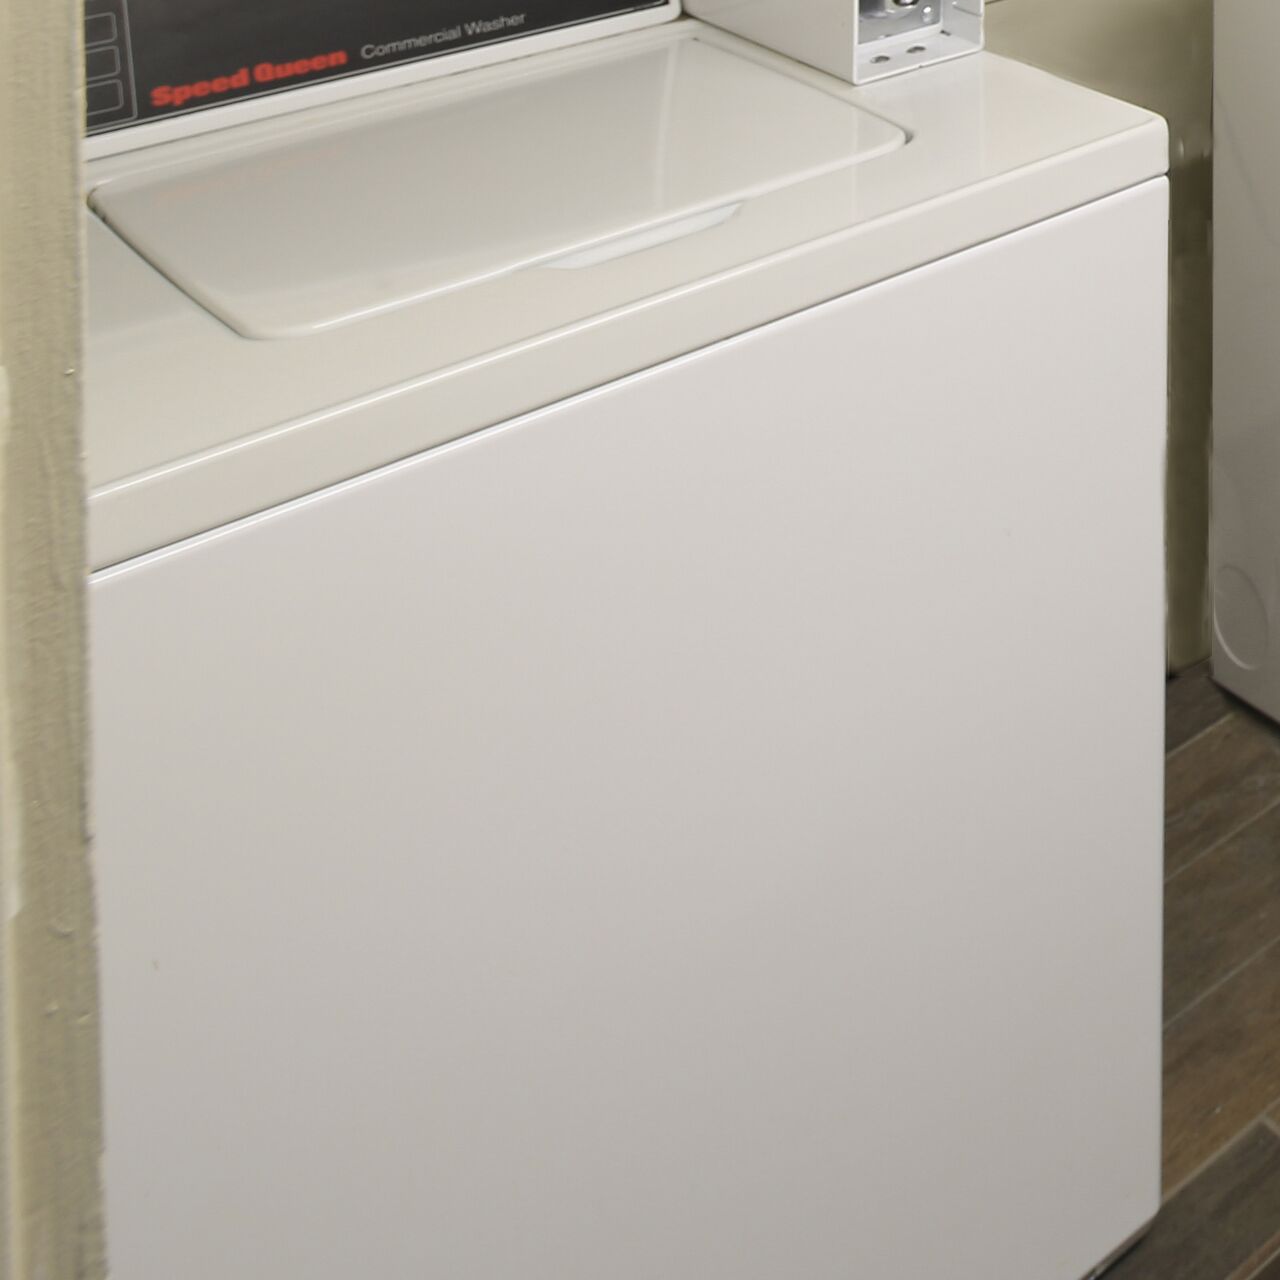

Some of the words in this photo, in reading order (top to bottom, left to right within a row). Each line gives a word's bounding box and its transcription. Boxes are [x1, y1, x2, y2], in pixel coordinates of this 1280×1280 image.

[360, 24, 463, 60] Commercial
[463, 12, 527, 36] Washer
[150, 66, 250, 107] Speed
[253, 50, 348, 83] Queen
